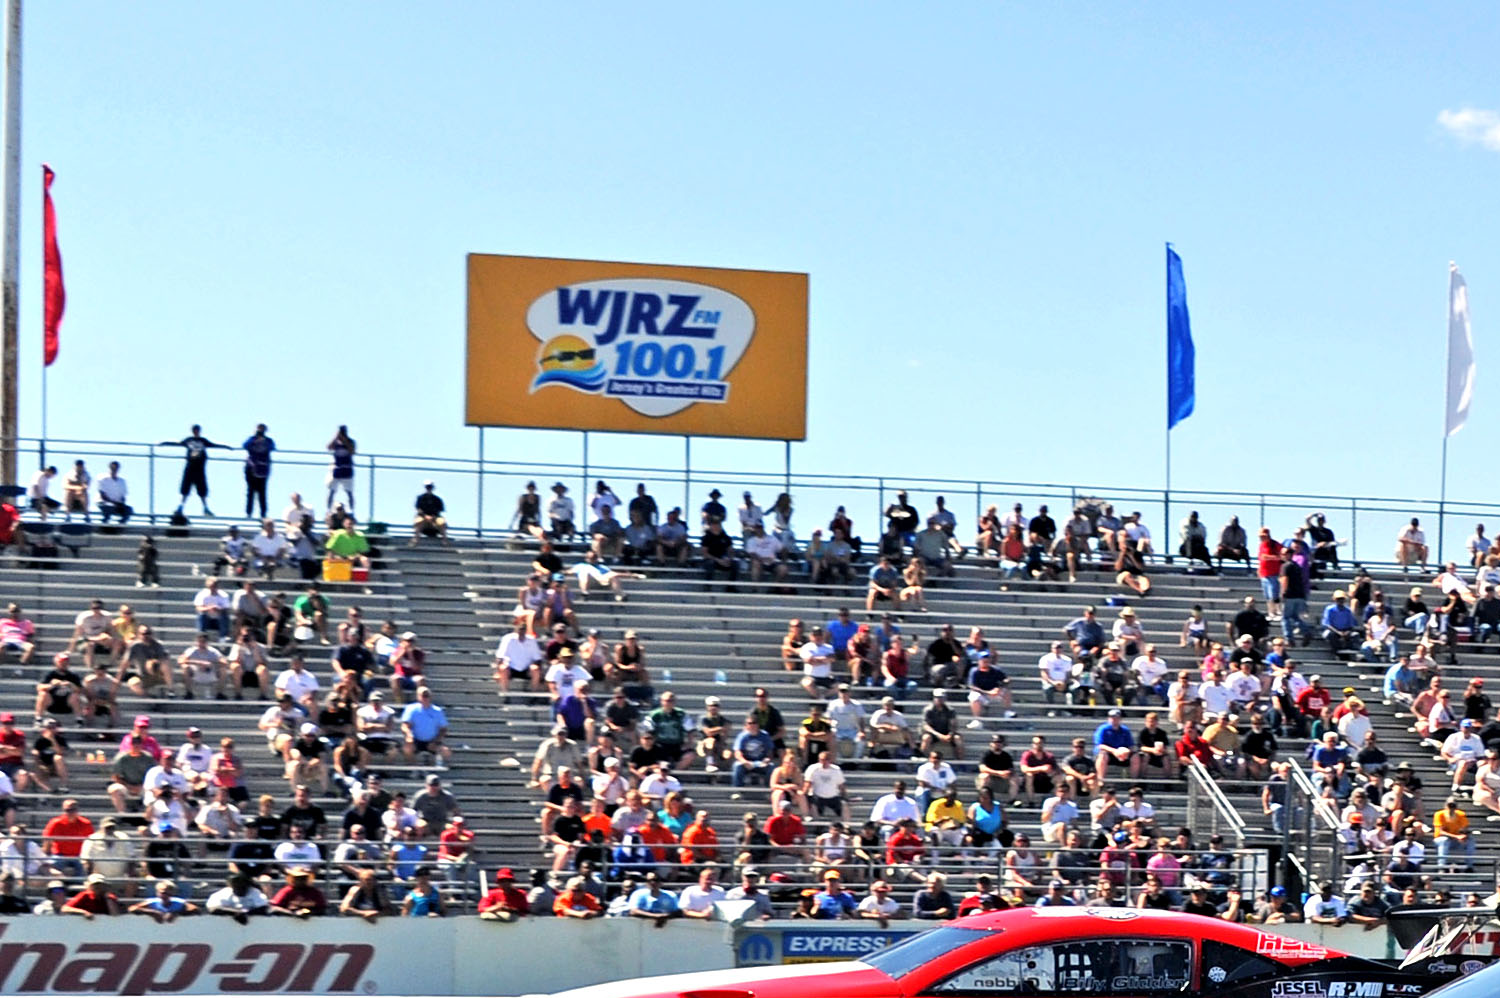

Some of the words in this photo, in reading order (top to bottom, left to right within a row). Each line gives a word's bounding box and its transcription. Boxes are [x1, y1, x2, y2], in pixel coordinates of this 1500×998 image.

[556, 287, 717, 345] WJRZ
[692, 311, 721, 325] FM
[614, 341, 726, 380] 100.1
[0, 940, 376, 995] nap-on
[1063, 977, 1105, 991] Billy
[1110, 975, 1188, 990] Glidden
[1273, 983, 1324, 995] JESEL
